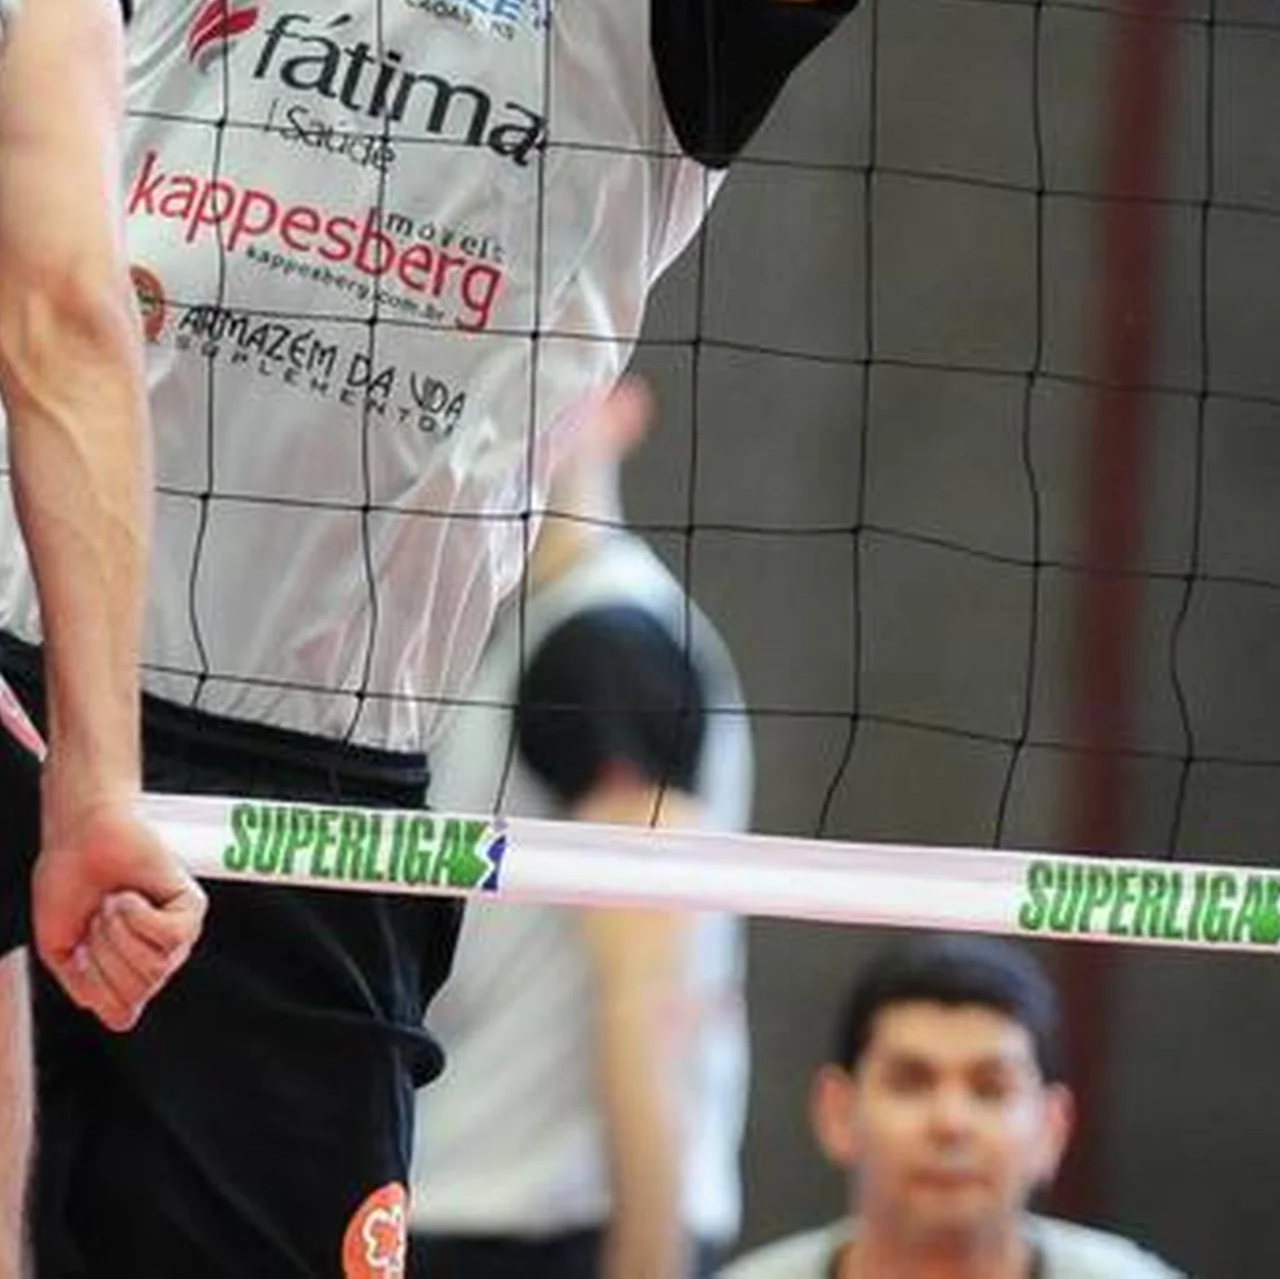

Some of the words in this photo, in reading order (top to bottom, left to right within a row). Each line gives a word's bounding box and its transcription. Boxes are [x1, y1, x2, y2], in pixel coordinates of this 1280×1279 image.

[253, 11, 548, 167] fátima
[128, 149, 503, 332] kappesberg
[346, 351, 397, 399] DA
[224, 803, 486, 888] SUPERLIGA
